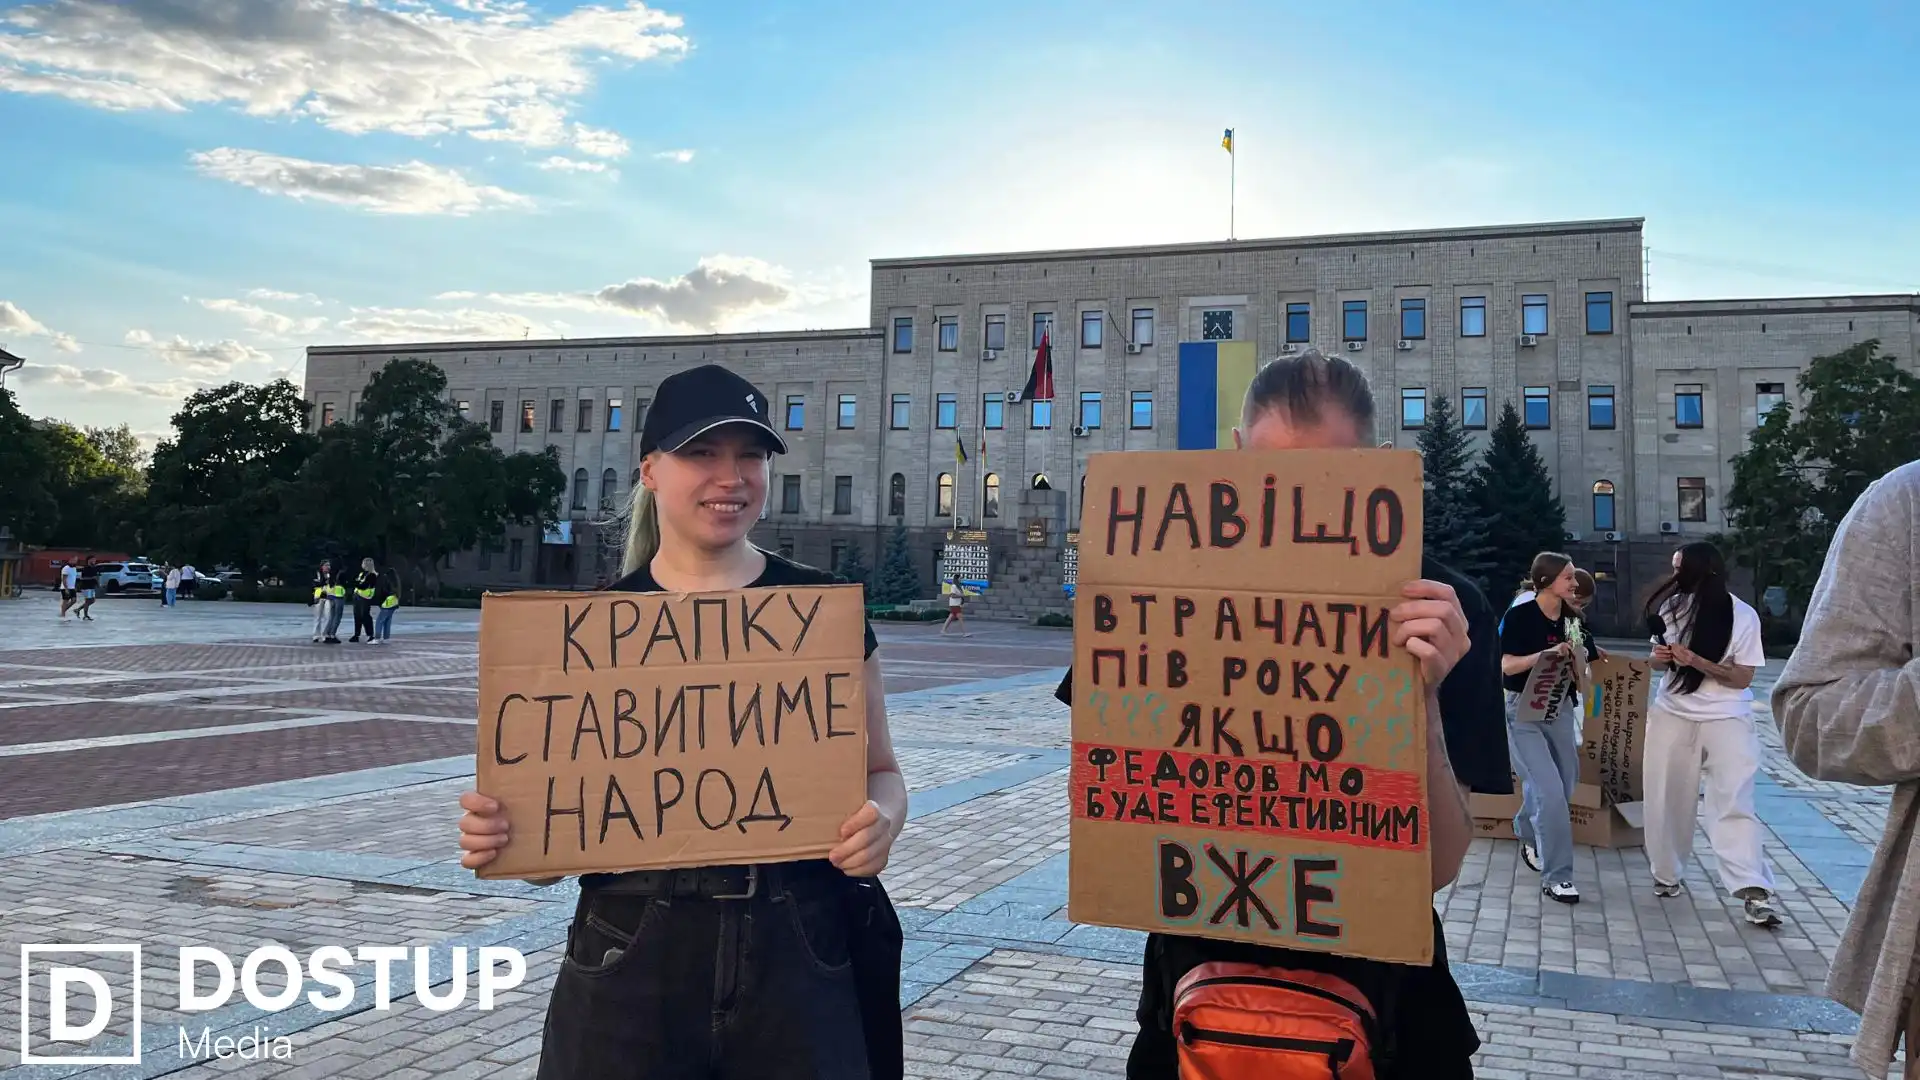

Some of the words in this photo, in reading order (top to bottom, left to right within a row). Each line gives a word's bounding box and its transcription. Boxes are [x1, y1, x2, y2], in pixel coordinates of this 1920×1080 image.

[563, 592, 823, 674] КРАПКУ
[1093, 593, 1390, 658] ВТРАЧАТИ
[1223, 656, 1350, 702] РОКУ
[495, 672, 857, 765] СТАВИТИМЕ
[1174, 703, 1343, 762] ЯКЩО
[1087, 748, 1278, 793] ФЕДОРОВ
[1300, 762, 1363, 796] МО
[544, 767, 794, 855] НАРОД
[1086, 786, 1180, 824] БУДЕ
[1191, 793, 1419, 845] ЕФЕКТИВНИМ
[1157, 839, 1344, 938] ВЖЕ
